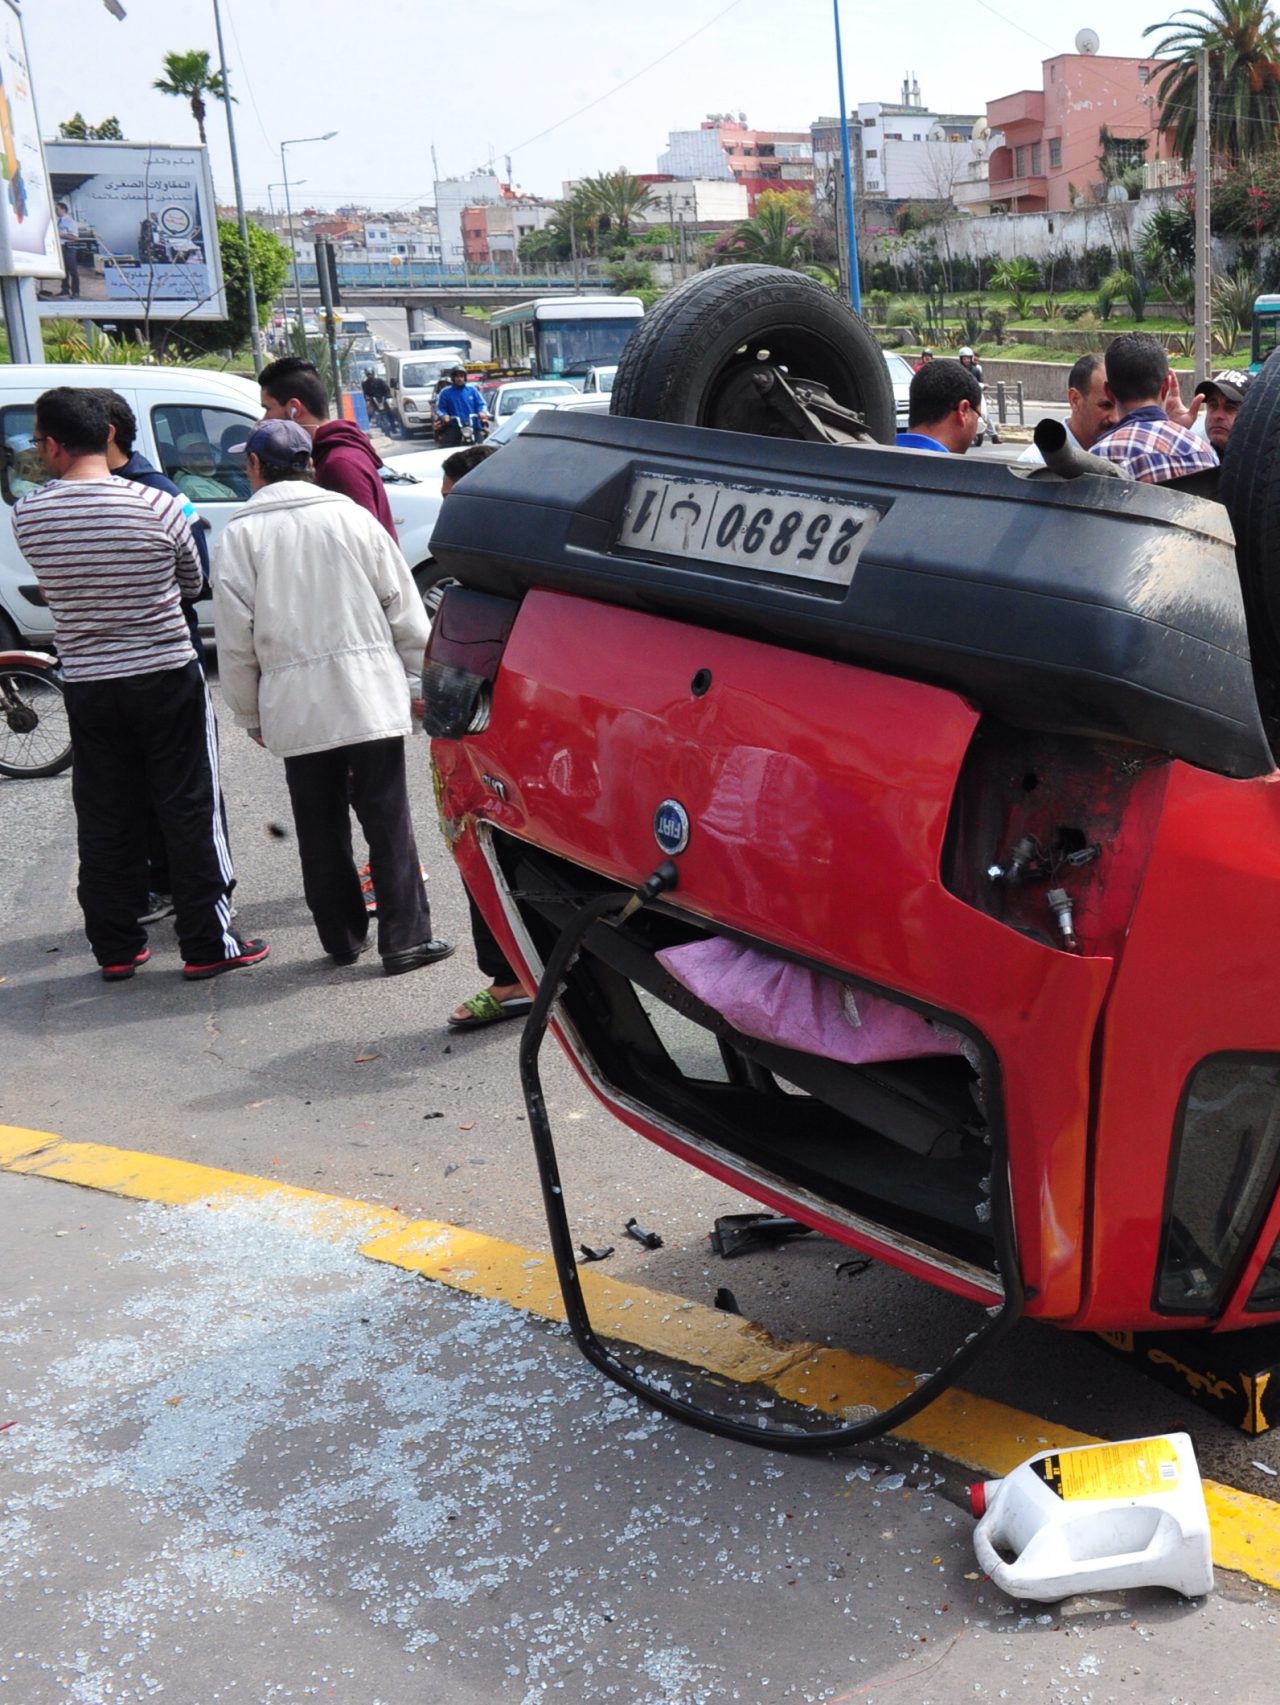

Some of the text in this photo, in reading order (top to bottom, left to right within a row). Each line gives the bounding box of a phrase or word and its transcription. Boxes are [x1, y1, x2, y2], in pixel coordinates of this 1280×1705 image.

[632, 489, 658, 534] 1
[716, 502, 864, 566] 25890
[657, 816, 682, 840] FIAT
